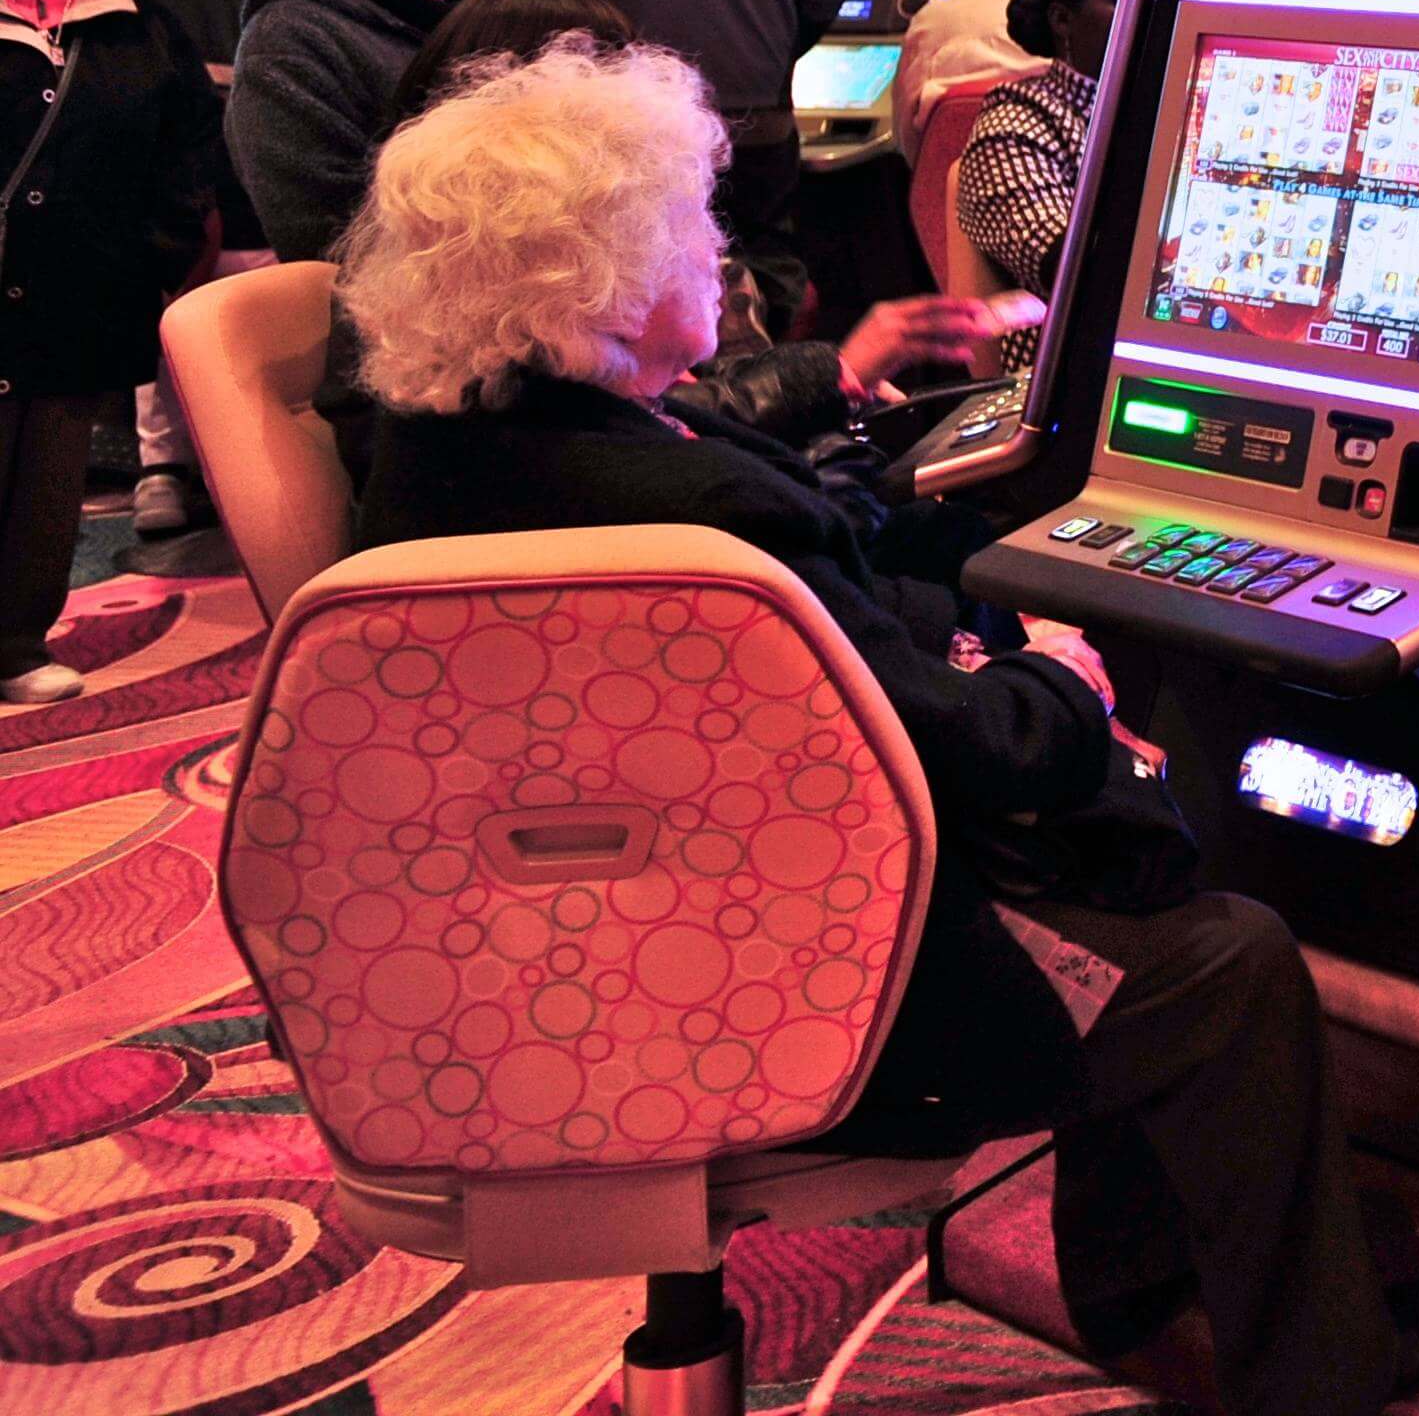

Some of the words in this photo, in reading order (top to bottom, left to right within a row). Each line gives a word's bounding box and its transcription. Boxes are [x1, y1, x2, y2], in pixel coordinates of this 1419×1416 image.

[1334, 47, 1362, 66] SEX
[1273, 178, 1296, 193] PLAY
[1298, 183, 1306, 193] 4
[1308, 184, 1342, 198] GAMES
[1378, 190, 1405, 206] SAME
[1320, 327, 1352, 346] $37.01
[1383, 339, 1403, 353] 400
